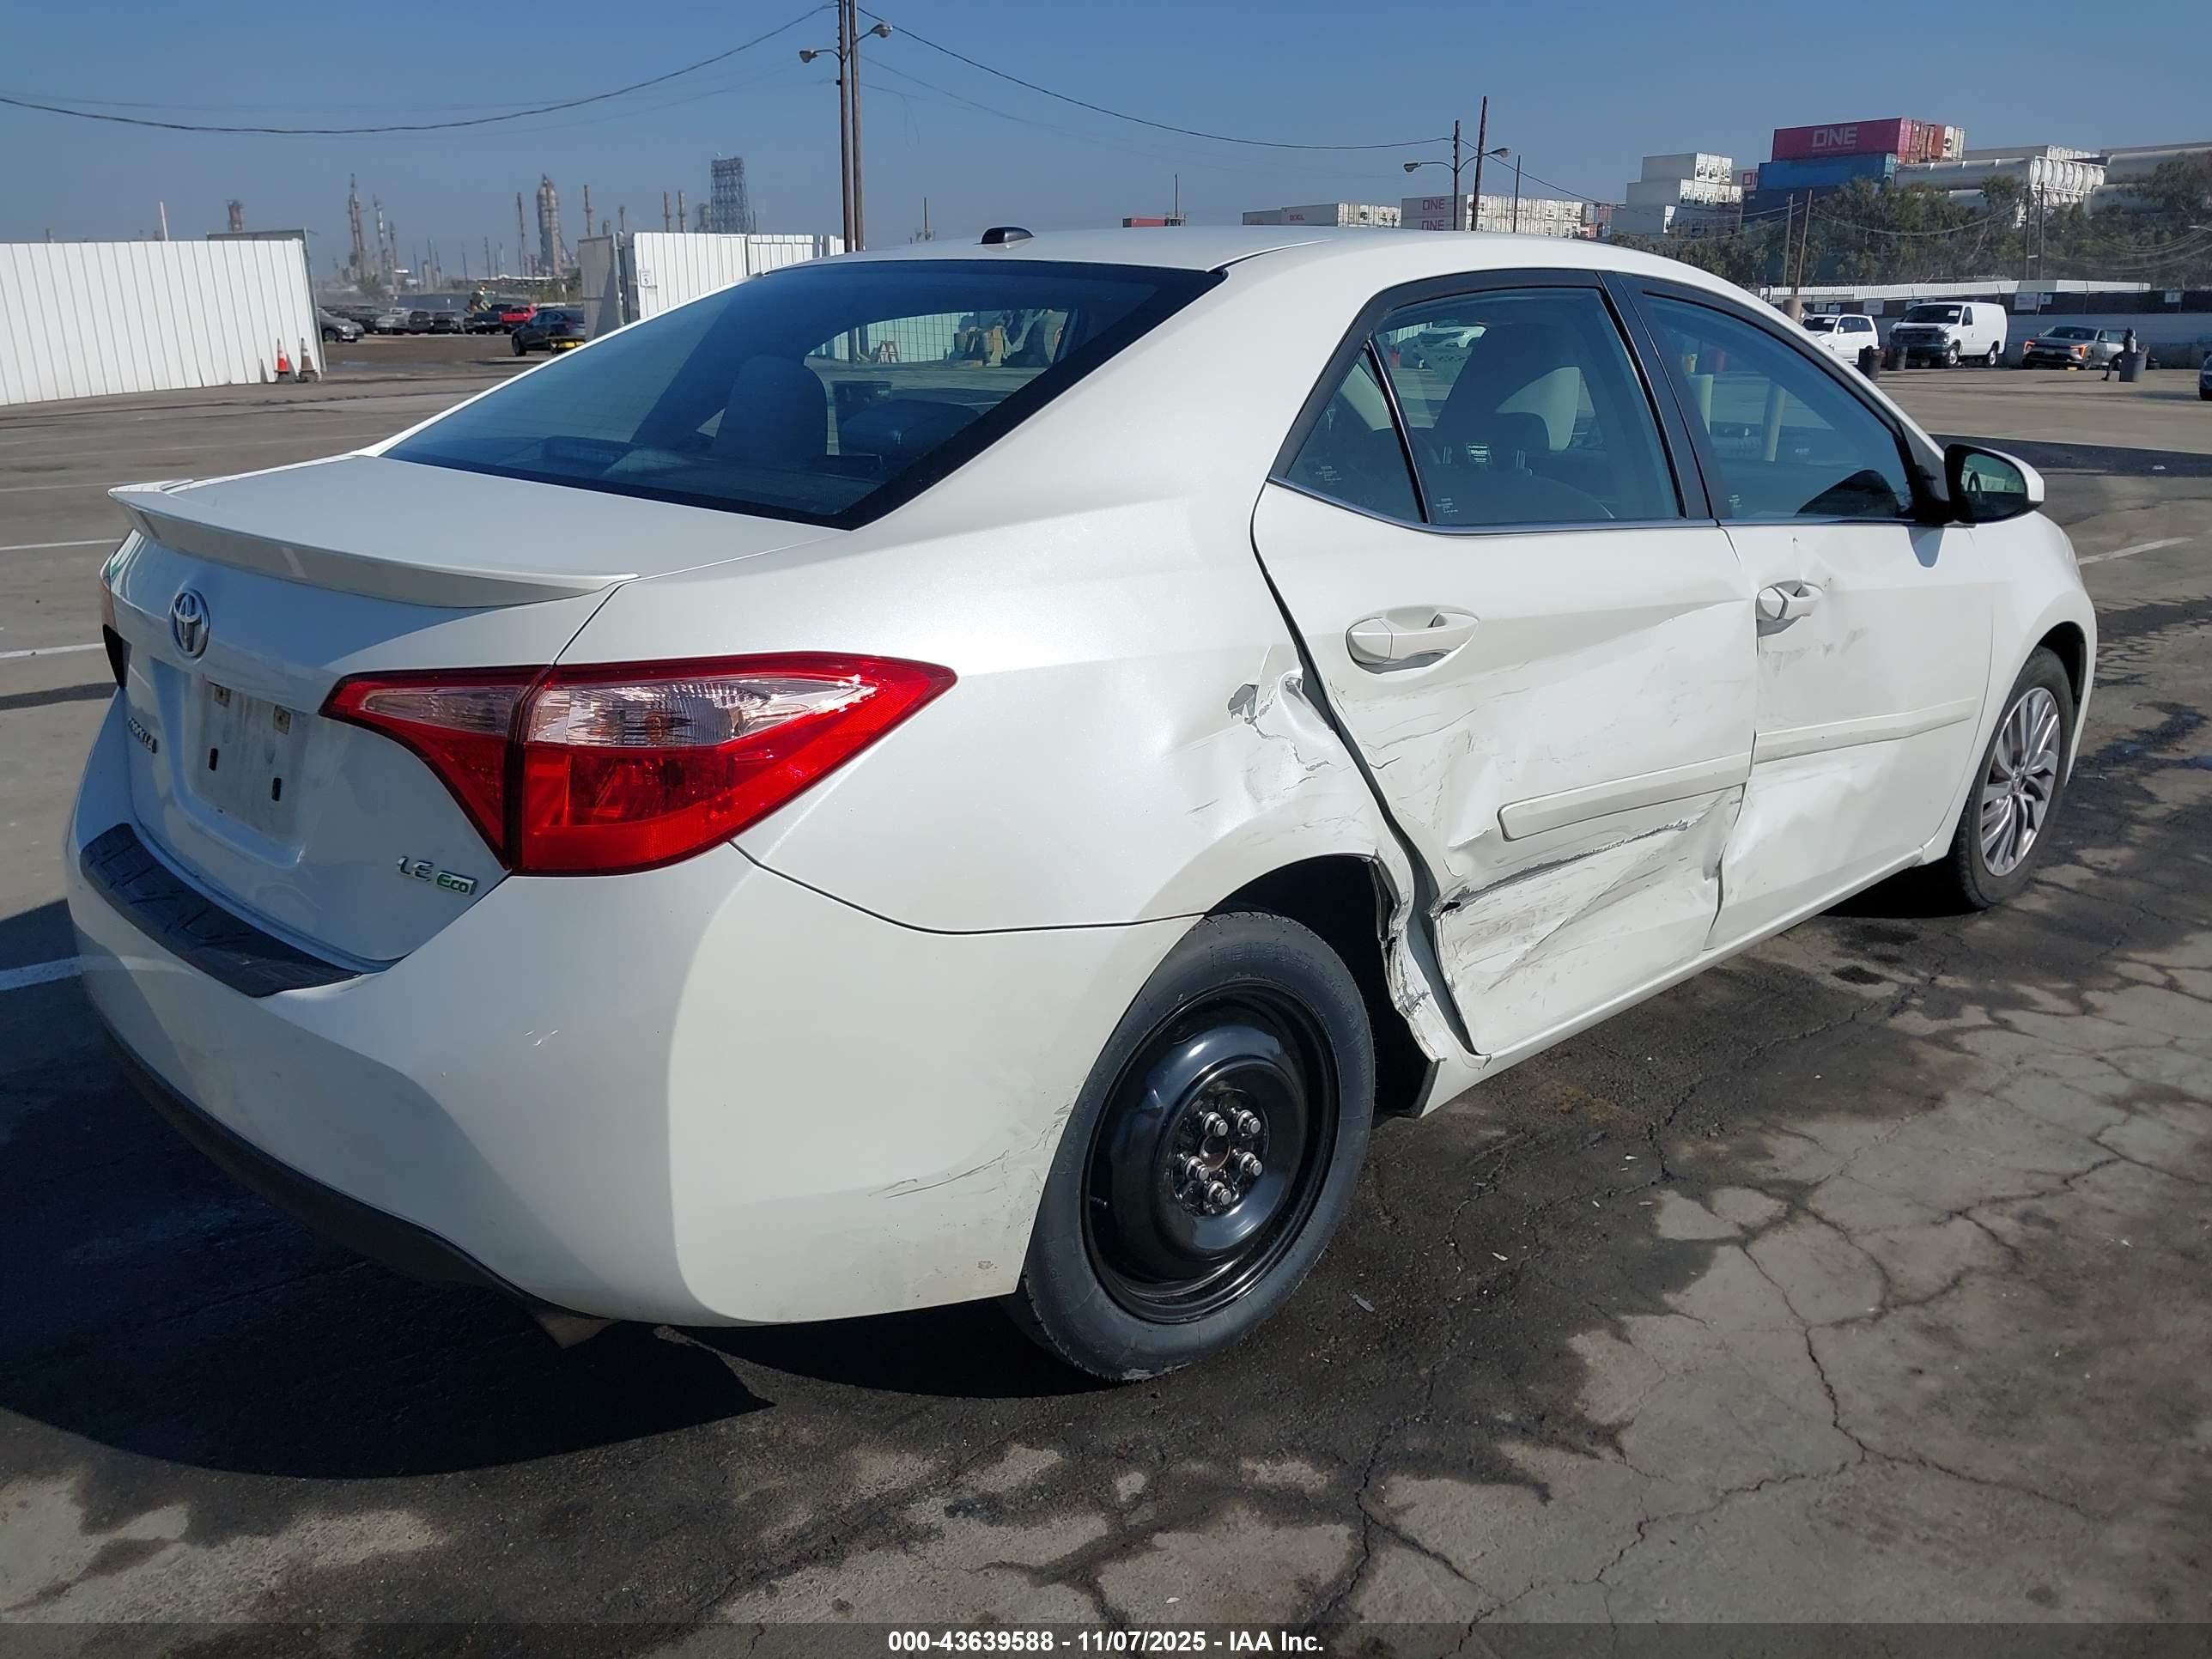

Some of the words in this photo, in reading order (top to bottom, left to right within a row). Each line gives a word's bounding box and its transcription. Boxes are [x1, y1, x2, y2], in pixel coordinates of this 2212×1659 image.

[1813, 127, 1857, 147] ONE
[1422, 198, 1445, 211] ONE
[1421, 219, 1444, 231] ONE
[397, 855, 434, 882] LE
[436, 872, 471, 895] Eco
